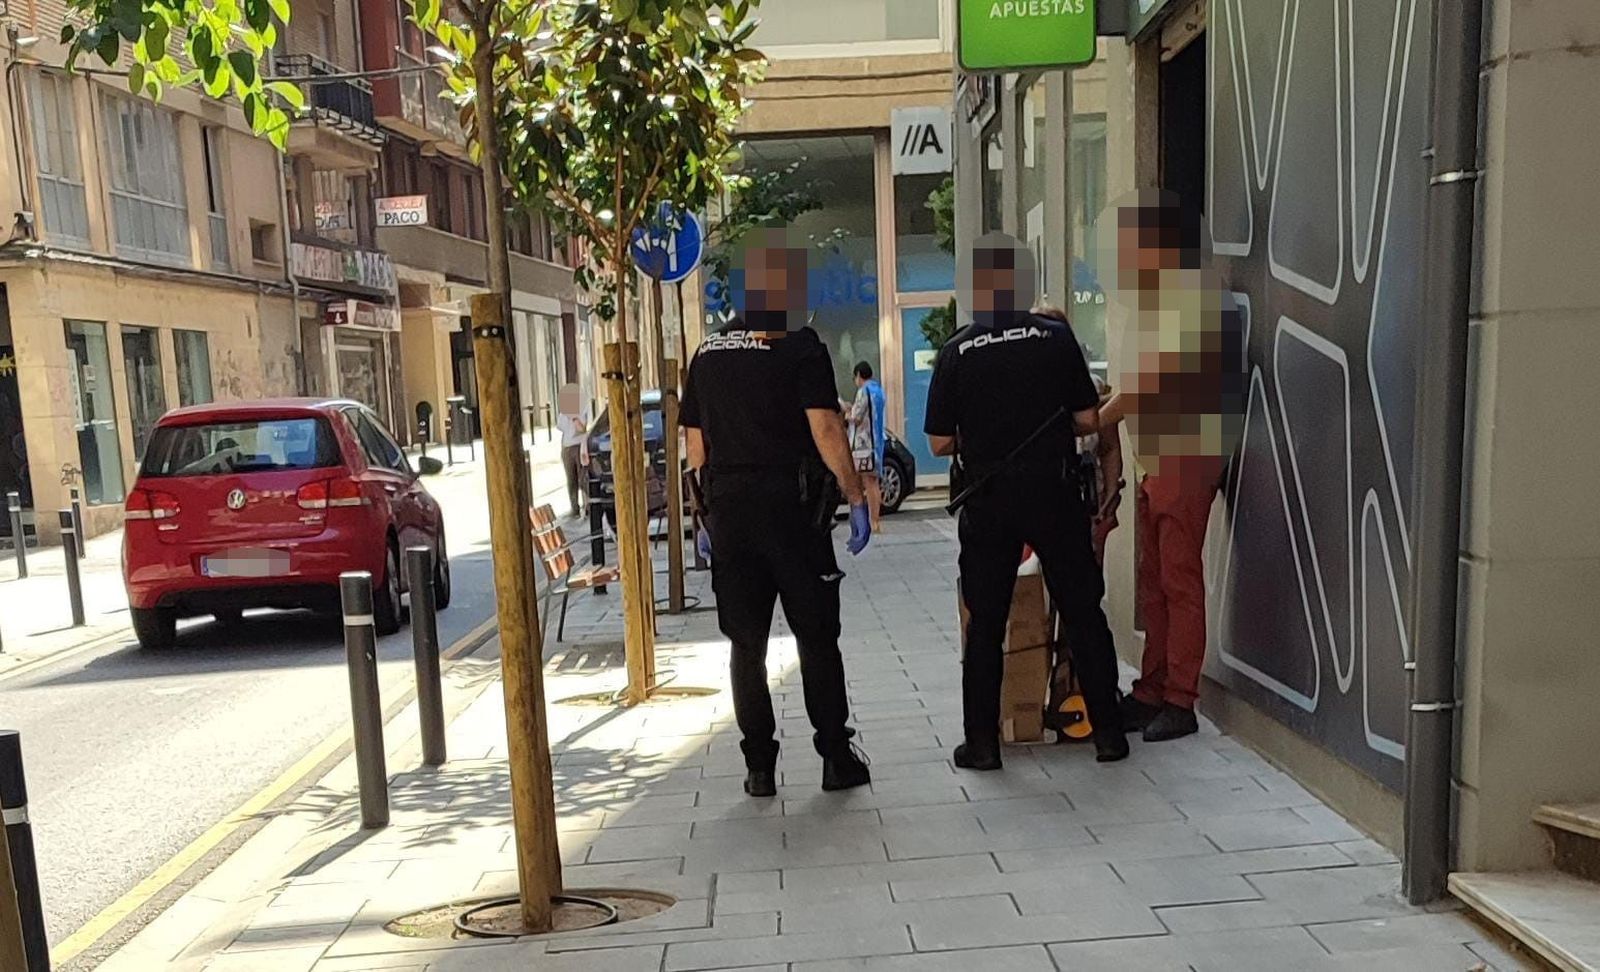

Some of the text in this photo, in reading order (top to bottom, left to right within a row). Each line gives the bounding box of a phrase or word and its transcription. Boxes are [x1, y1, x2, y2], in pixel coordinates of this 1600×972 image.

[989, 0, 1085, 19] APUESTAS
[384, 211, 420, 225] PACO
[958, 326, 1042, 356] POLICIA
